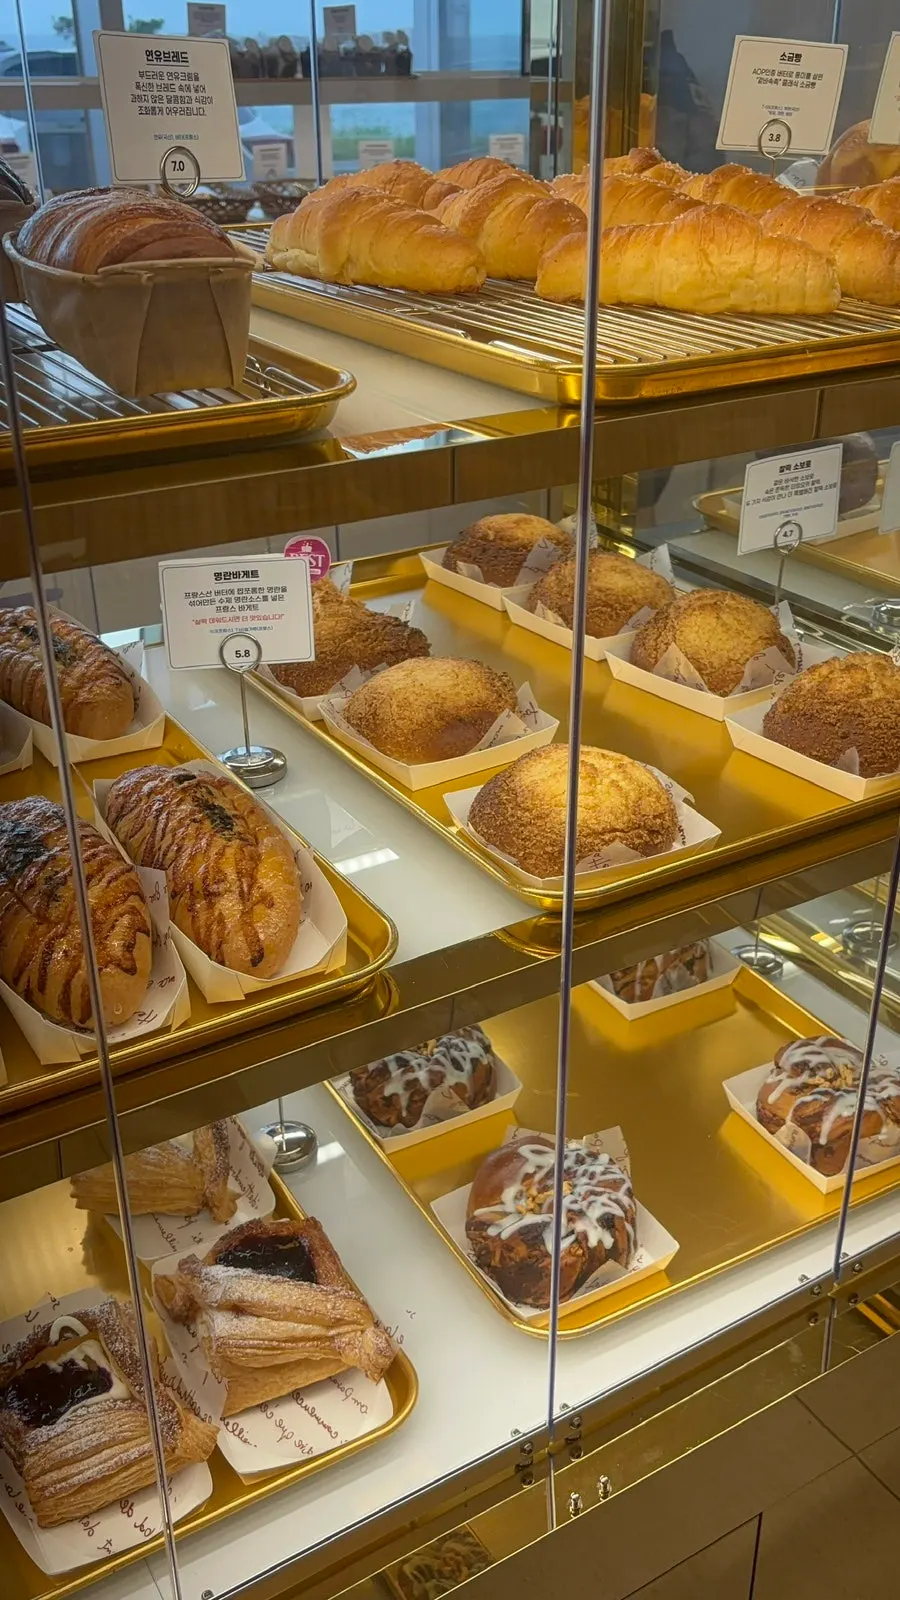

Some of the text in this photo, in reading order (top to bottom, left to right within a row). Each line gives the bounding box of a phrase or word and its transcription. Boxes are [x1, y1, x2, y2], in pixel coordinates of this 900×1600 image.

[145, 49, 189, 63] 연유브레드
[779, 51, 803, 63] 소금빵
[138, 70, 200, 82] 부드러운 연유크림을
[777, 70, 795, 78] 버터로
[135, 82, 206, 94] 폭신한 브레드 속에 넣어
[782, 79, 799, 87] 클래식
[800, 81, 817, 89] 소금빵
[130, 93, 214, 105] 과하지 않은 달콤함과 식감이
[138, 105, 207, 117] 조화롭게 어우러집니다.
[768, 133, 781, 142] 3.8
[171, 160, 185, 172] 7.0
[779, 460, 812, 474] 찰떡 소보로
[799, 473, 815, 482] 소보로
[782, 529, 794, 538] 4.7
[214, 569, 260, 582] 명란바게트
[184, 590, 213, 600] 프랑스산
[214, 587, 236, 597] 버터에
[266, 585, 288, 595] 명란을
[188, 593, 285, 607] 섞어만든 수제 명란소스를 넣은
[215, 604, 260, 614] 프랑스 바게트
[208, 616, 241, 625] 데워드시면
[235, 649, 251, 659] 5.8
